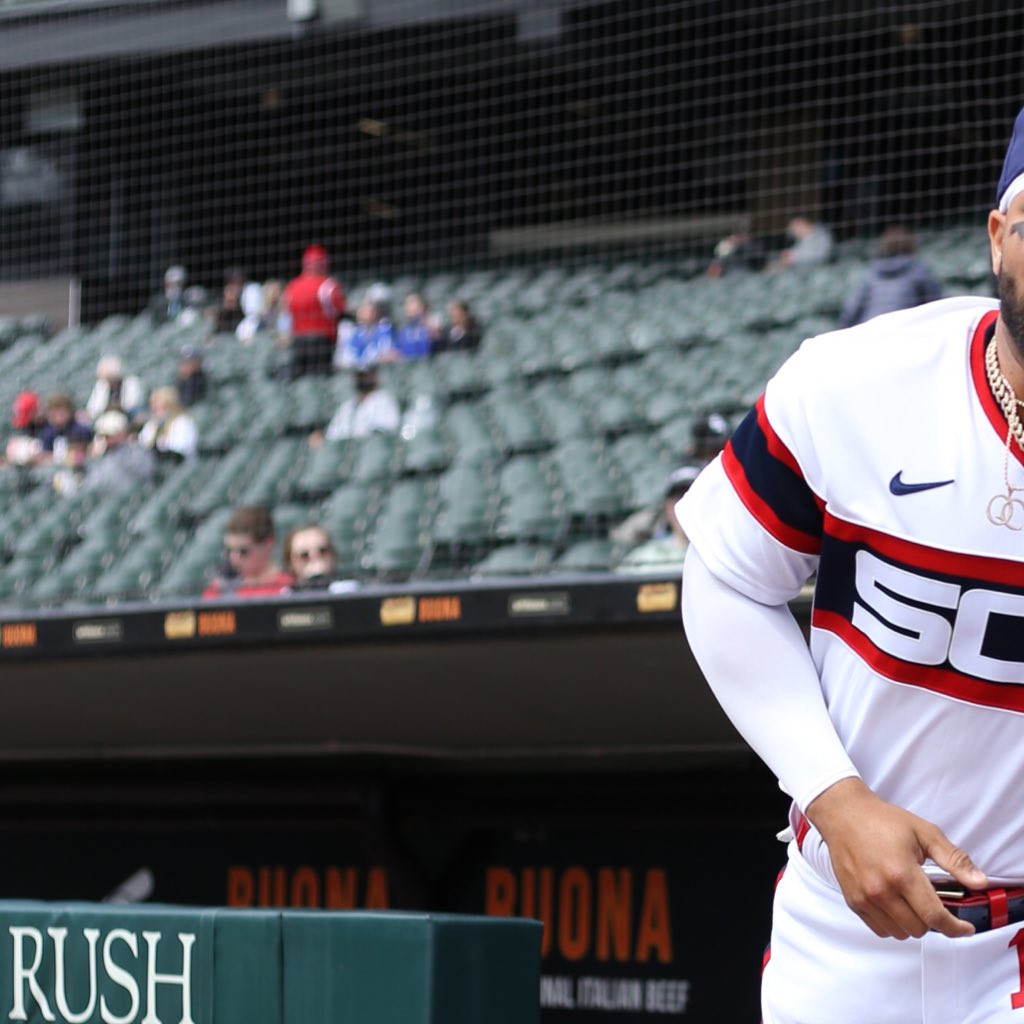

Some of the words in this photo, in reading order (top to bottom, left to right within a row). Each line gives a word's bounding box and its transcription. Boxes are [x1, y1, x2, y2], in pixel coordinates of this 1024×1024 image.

[485, 866, 674, 963] BUONA
[577, 975, 642, 1011] ITALIAN
[645, 978, 690, 1014] BEEF
